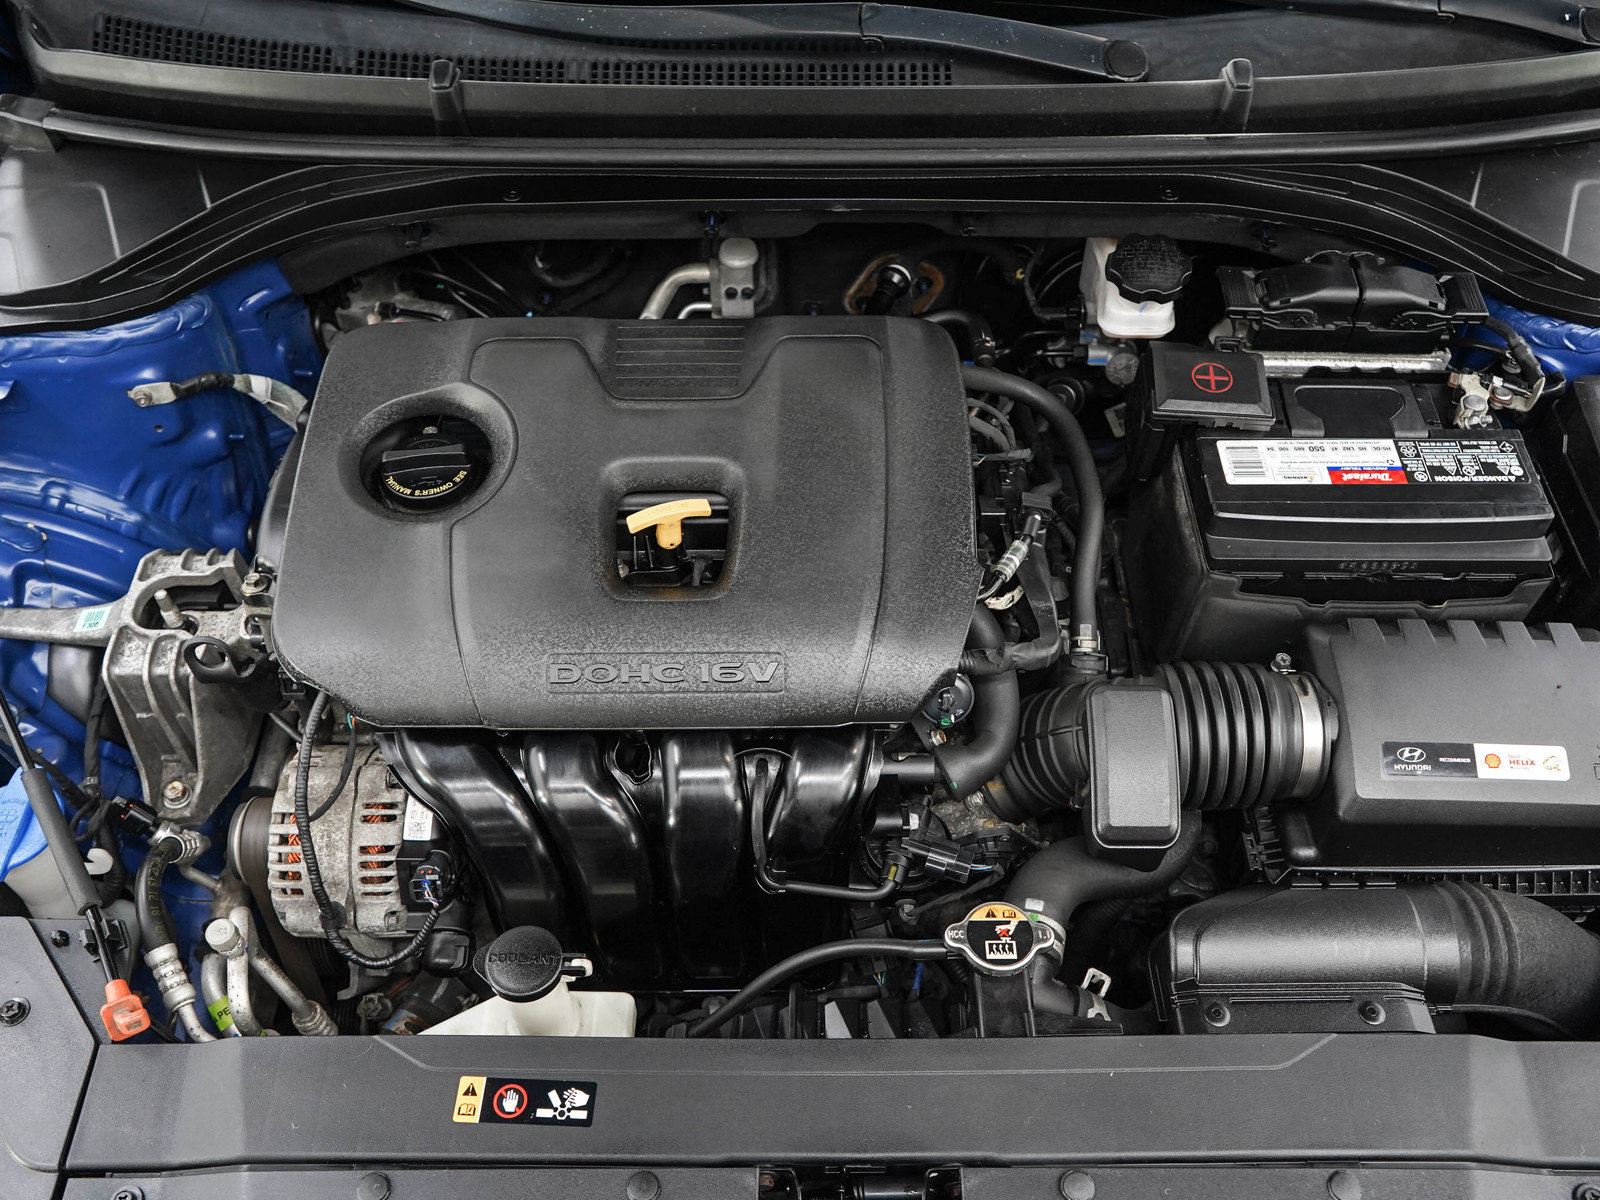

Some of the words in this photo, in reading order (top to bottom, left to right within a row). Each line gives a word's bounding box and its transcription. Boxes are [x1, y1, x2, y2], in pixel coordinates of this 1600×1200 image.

[453, 470, 467, 483] SEE
[1341, 472, 1393, 482] Duralast
[385, 475, 413, 495] MANUAL
[414, 481, 454, 496] OWNER'S
[549, 662, 686, 685] DOHC
[700, 661, 780, 684] 16V
[1394, 763, 1432, 771] HYUNDAI
[1508, 759, 1536, 767] HELIX
[947, 929, 965, 939] HCC
[488, 951, 561, 967] COOLANT
